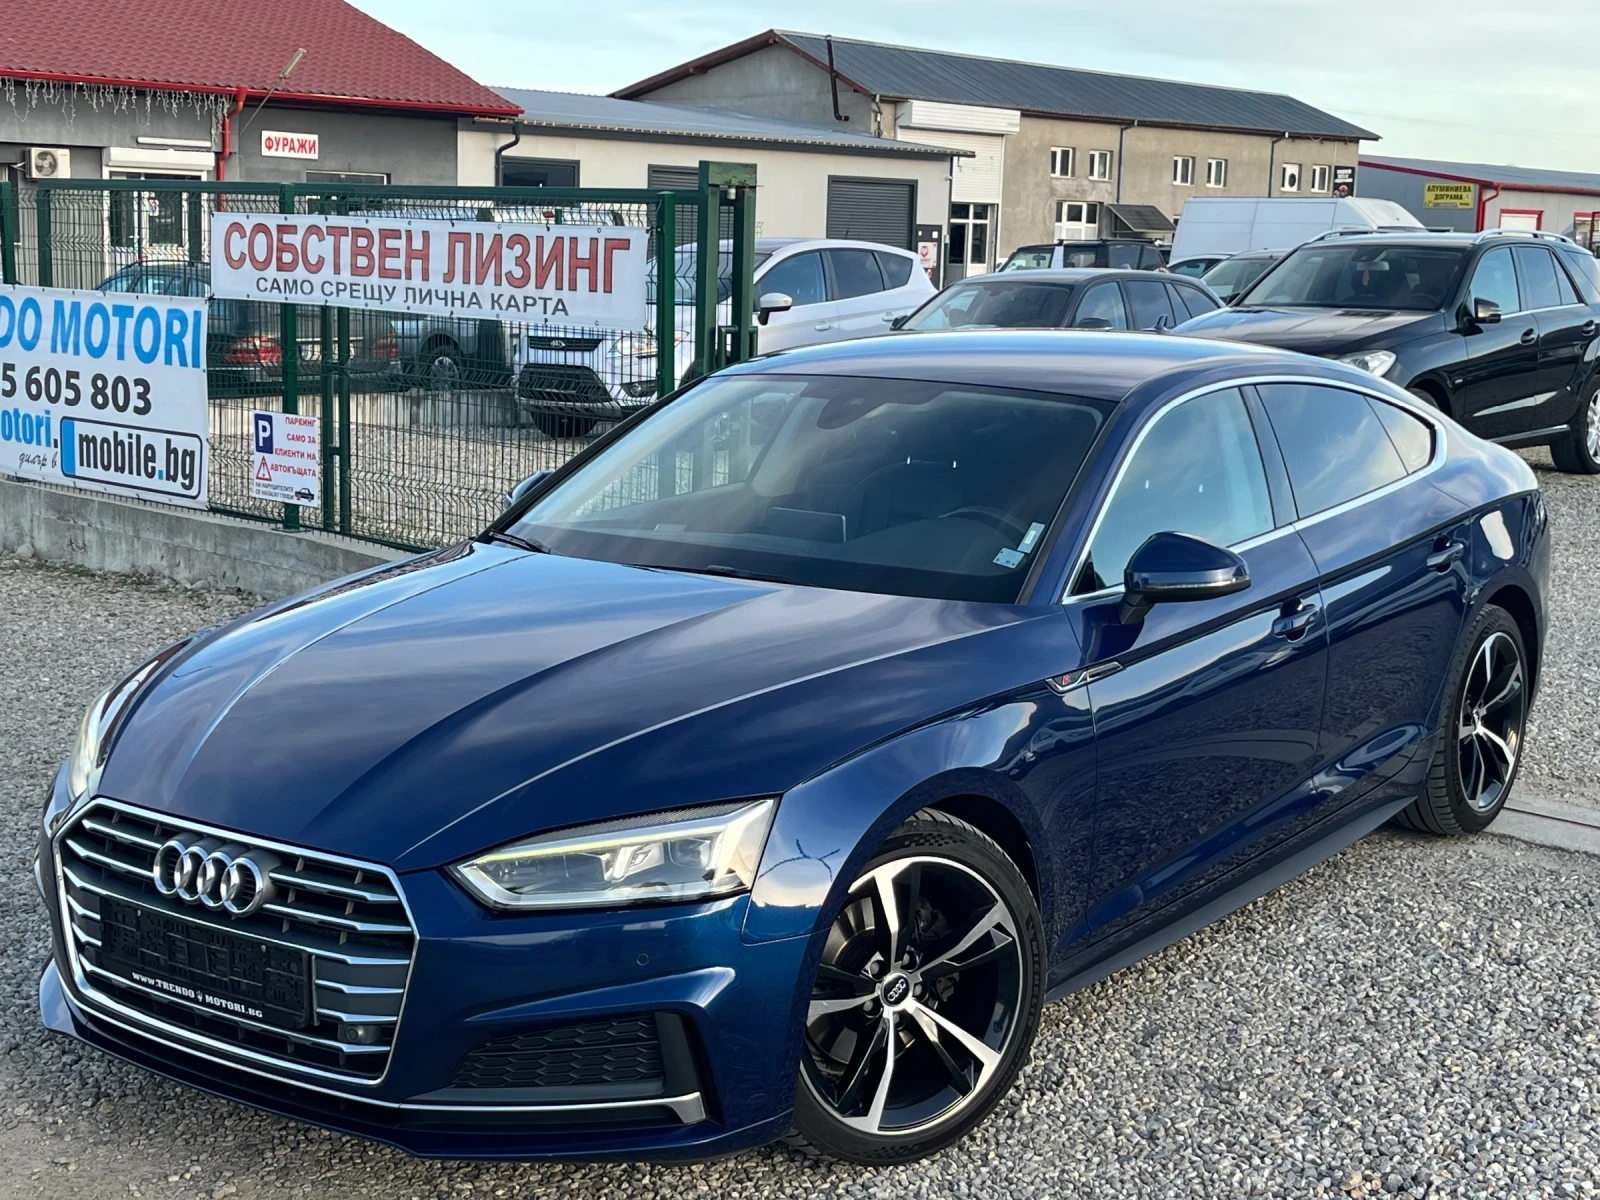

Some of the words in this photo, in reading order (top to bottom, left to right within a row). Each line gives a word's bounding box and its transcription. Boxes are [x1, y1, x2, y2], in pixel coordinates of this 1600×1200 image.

[265, 136, 316, 154] ФУРАЖИ
[224, 222, 430, 282] СОБСТВЕН
[443, 231, 630, 293] ЛИЗИНГ
[256, 277, 314, 295] САМО
[321, 280, 396, 305] СРЕЩУ
[404, 286, 483, 309] ЛИЧНА
[490, 292, 569, 316] КАРТА
[51, 300, 201, 369] MOTORI
[1, 362, 17, 398] 5
[25, 366, 81, 406] 605
[90, 373, 152, 416] 803
[285, 416, 316, 427] ПАРКИНГ
[287, 433, 306, 443] САМО
[307, 436, 316, 444] ЗА
[78, 431, 196, 490] mobile.bg
[275, 447, 305, 459] КЛИЕНТИ
[307, 452, 316, 461] НА
[270, 464, 316, 477] АВТОКЪЩАТА
[205, 994, 263, 1018] MOTORI.BG
